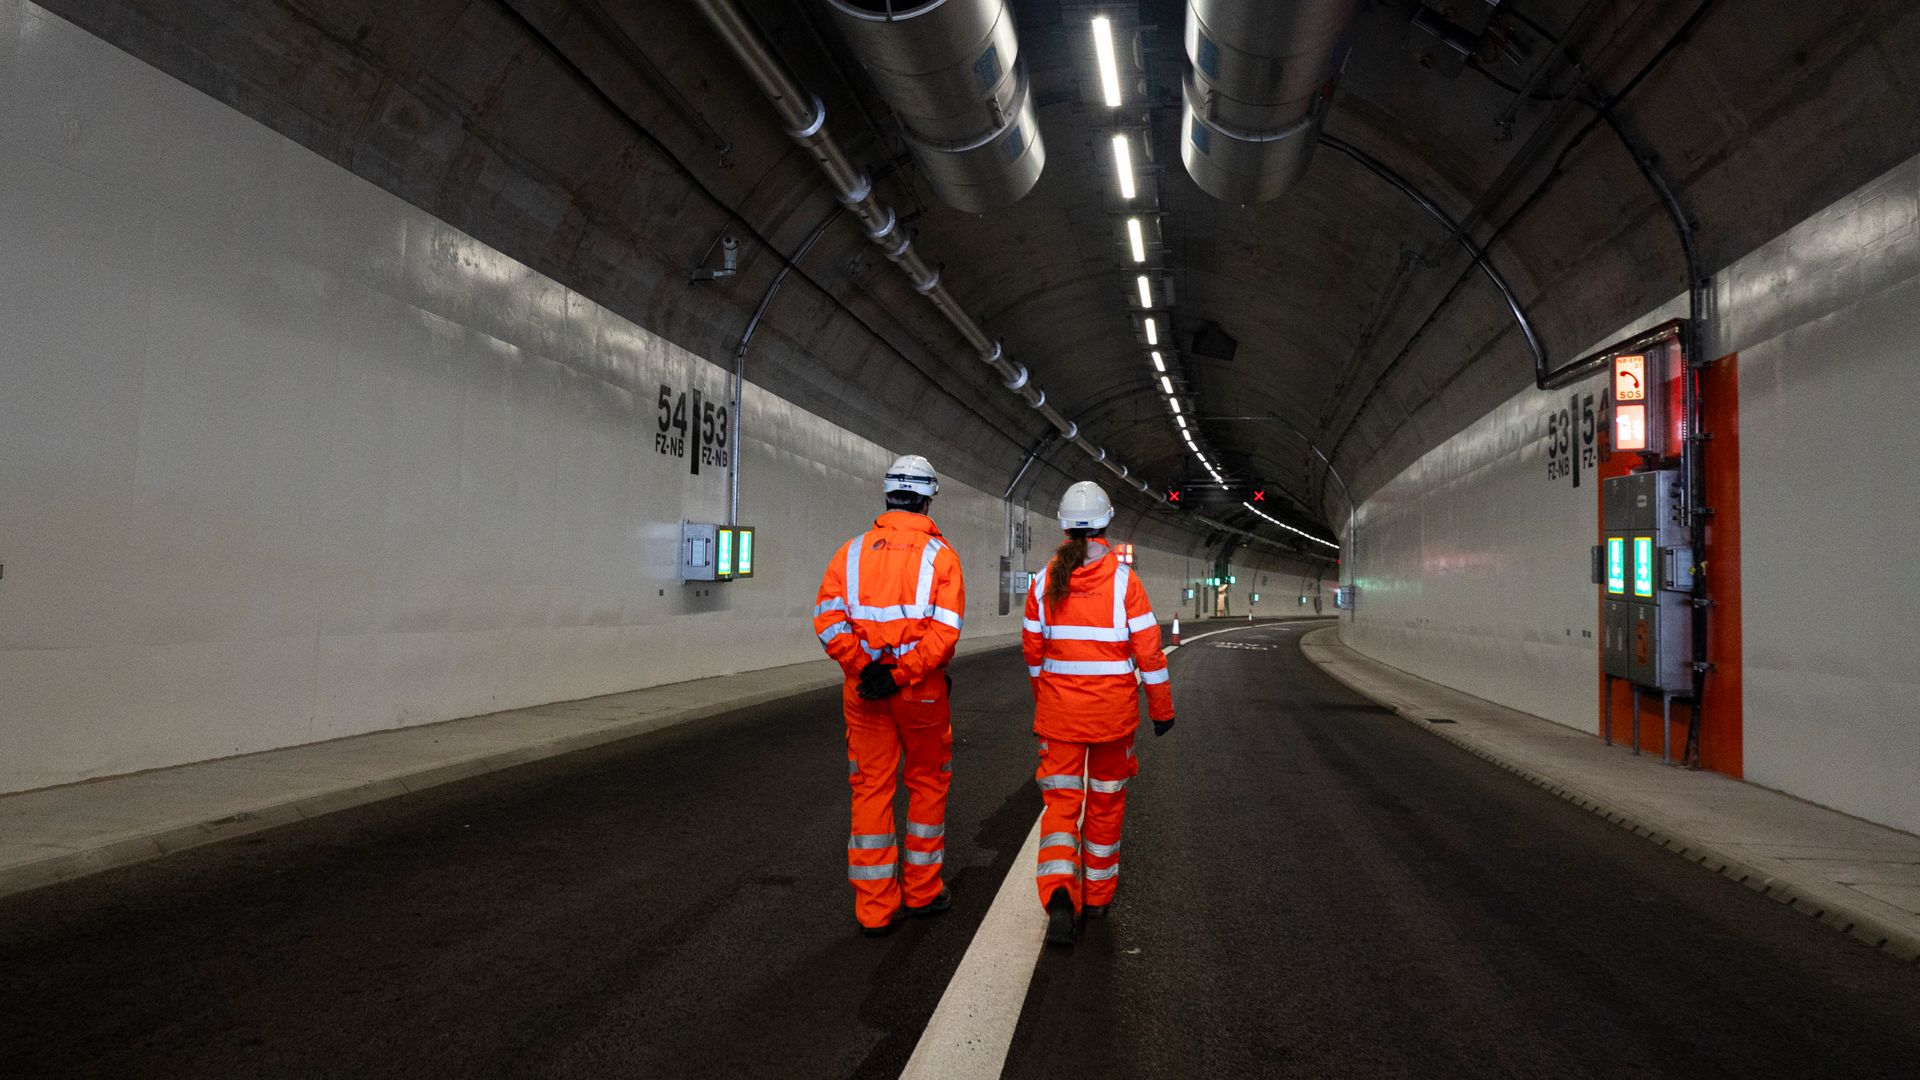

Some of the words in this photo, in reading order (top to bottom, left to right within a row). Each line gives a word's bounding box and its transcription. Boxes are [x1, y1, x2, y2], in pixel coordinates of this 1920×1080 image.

[658, 384, 688, 438] 54
[1619, 390, 1642, 399] SOS
[702, 401, 728, 449] 53
[1548, 408, 1569, 459] 53
